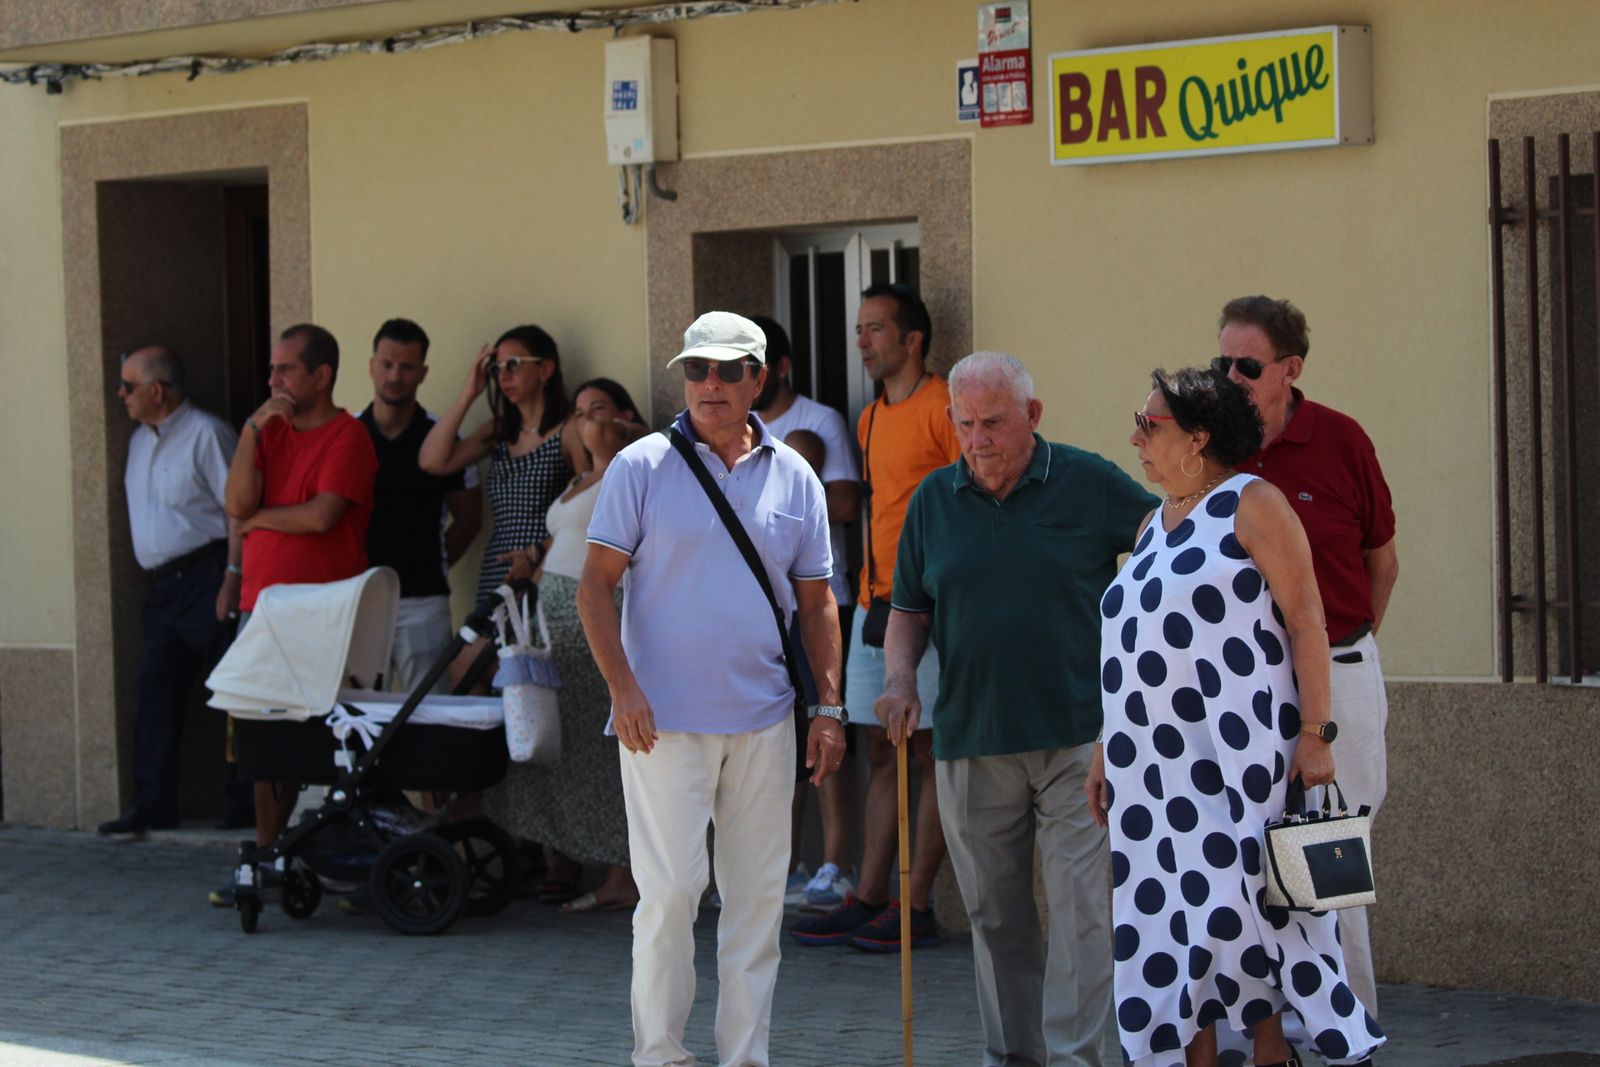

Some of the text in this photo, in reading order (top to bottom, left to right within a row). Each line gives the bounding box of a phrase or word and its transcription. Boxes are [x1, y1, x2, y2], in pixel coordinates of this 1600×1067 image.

[982, 55, 1026, 72] Alarma
[1059, 43, 1330, 145] BAR Quique
